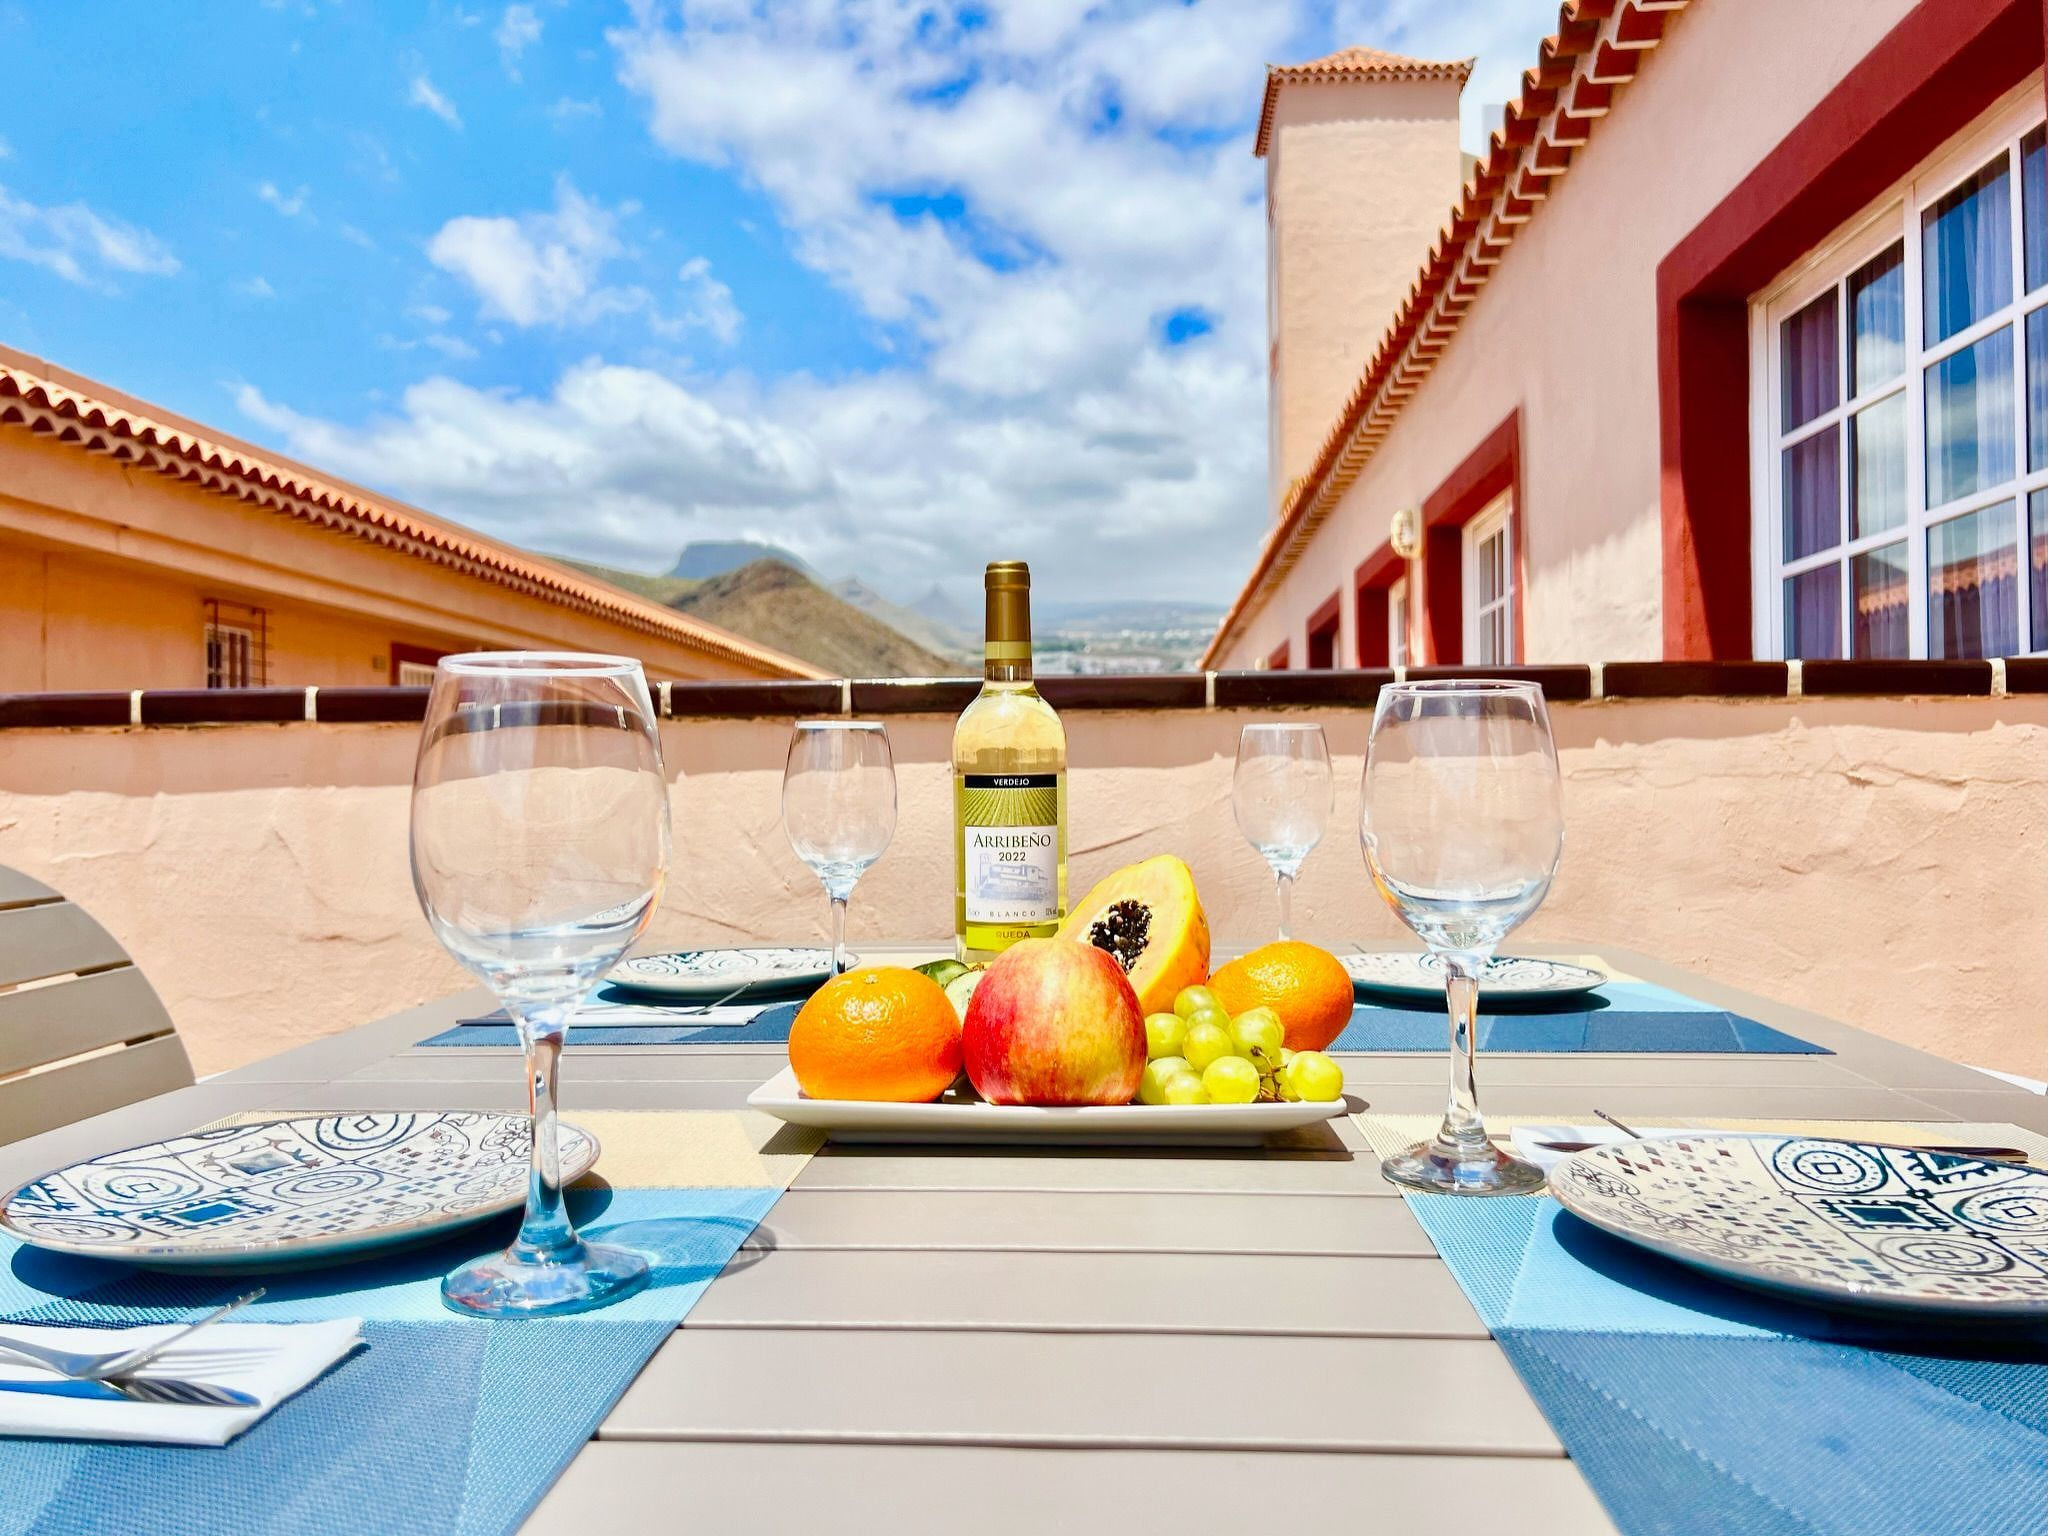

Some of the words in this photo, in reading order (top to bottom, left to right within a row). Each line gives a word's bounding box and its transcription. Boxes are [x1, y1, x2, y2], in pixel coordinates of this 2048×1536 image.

[993, 778, 1030, 786] VERDEJO
[973, 832, 1051, 848] ARRIBEÑO
[998, 852, 1026, 861] 2022
